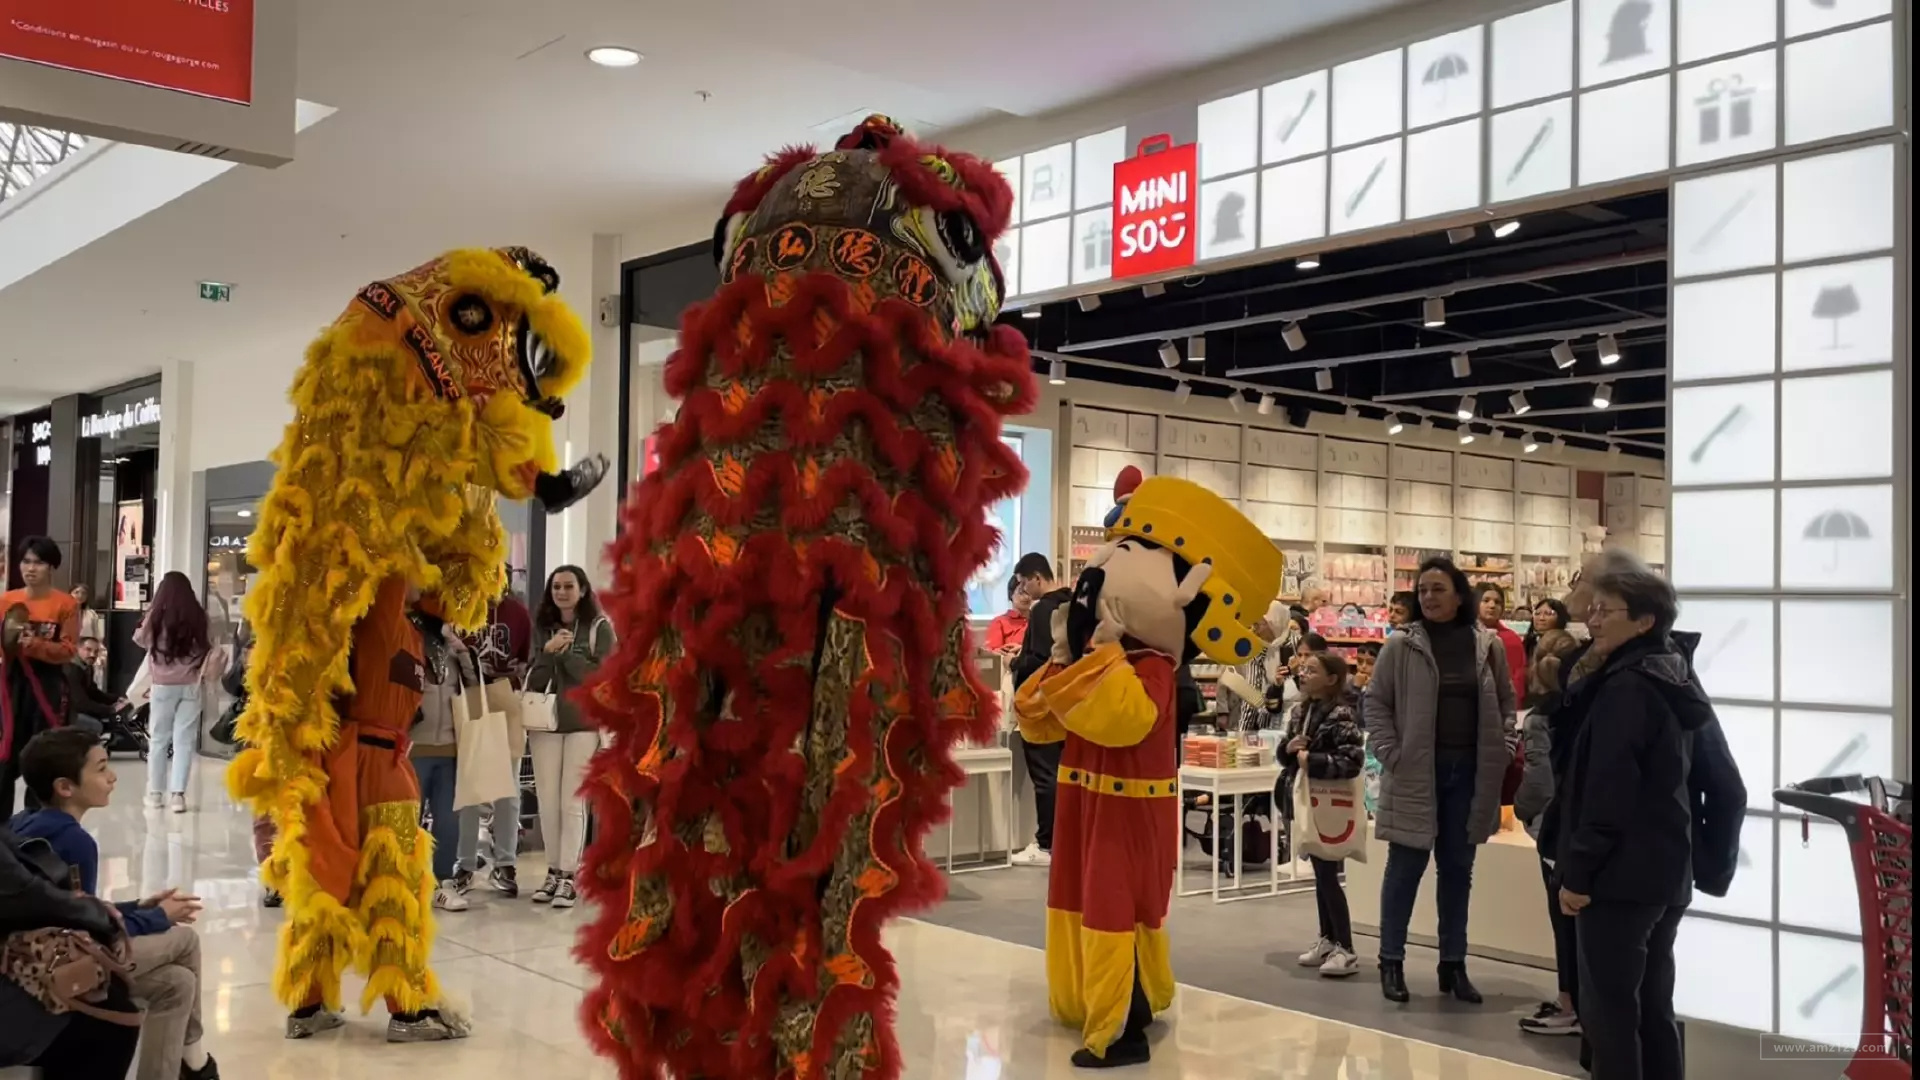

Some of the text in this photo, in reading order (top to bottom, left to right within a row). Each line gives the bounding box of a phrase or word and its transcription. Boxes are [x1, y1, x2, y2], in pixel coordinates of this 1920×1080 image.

[1120, 170, 1187, 216] MINI
[412, 323, 460, 399] FRANCE
[90, 409, 122, 439] Boutique
[123, 403, 134, 428] du
